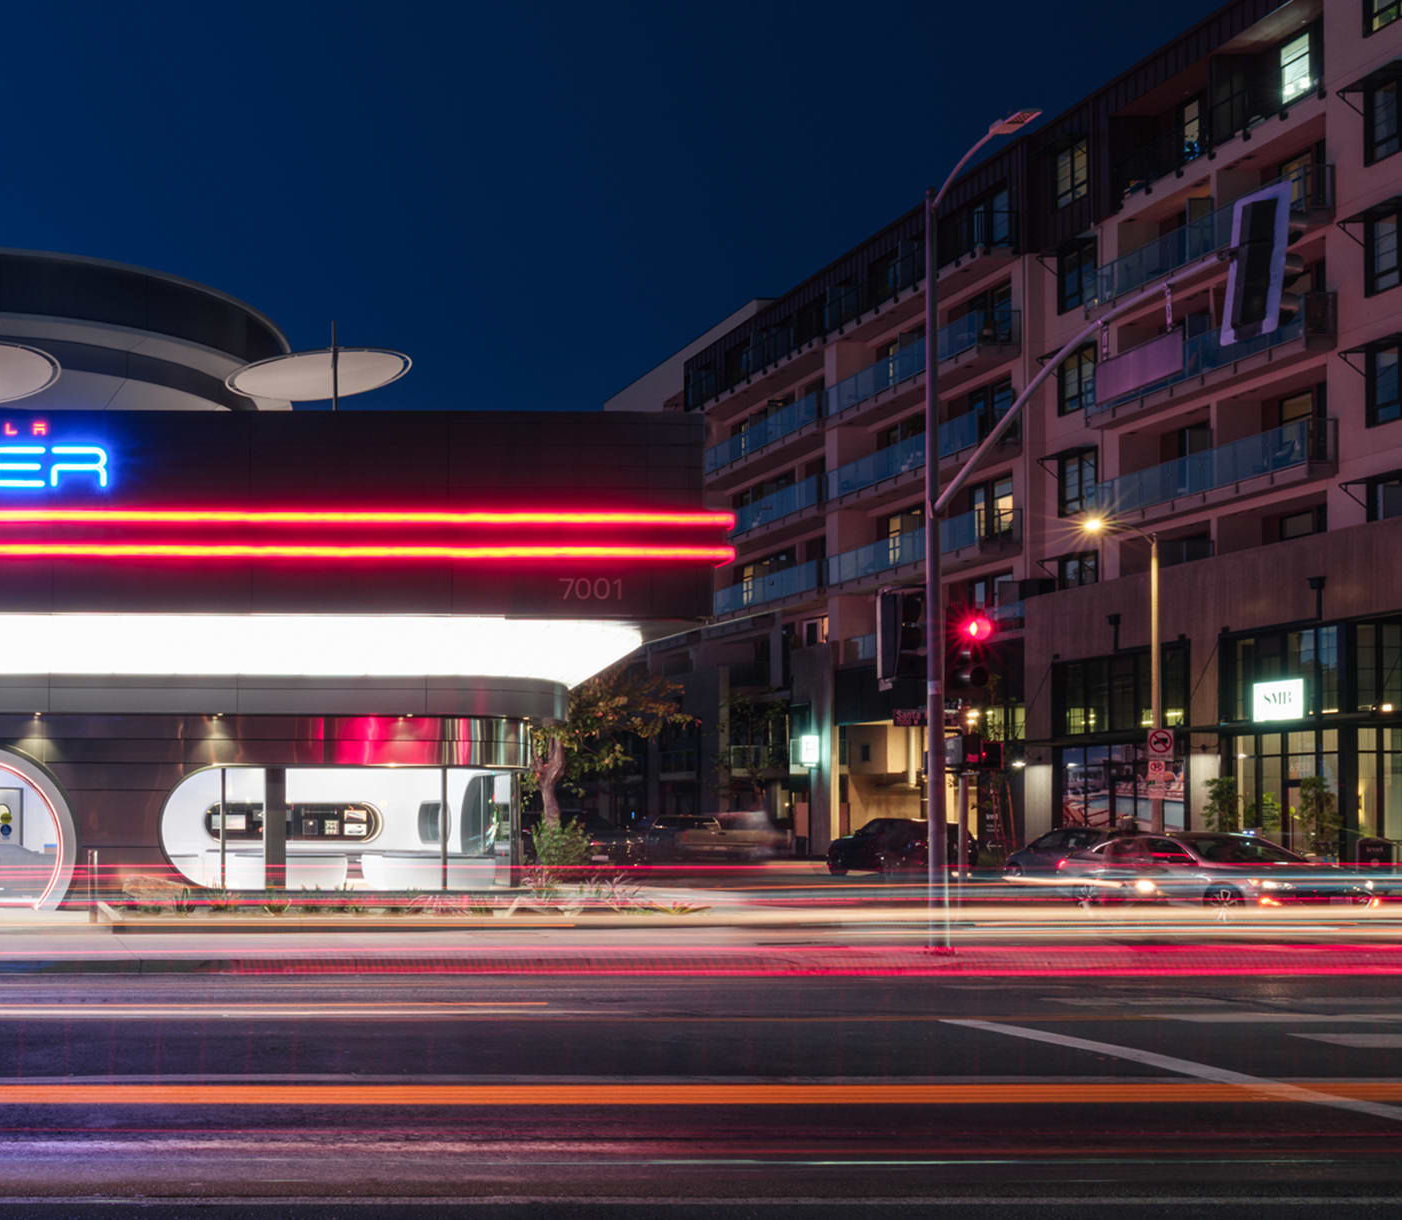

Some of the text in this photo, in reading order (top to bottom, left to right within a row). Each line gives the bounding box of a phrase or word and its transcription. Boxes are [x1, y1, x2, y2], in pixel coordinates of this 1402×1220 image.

[558, 577, 622, 600] 7001
[1263, 691, 1292, 704] SMB
[897, 708, 920, 720] Santa
